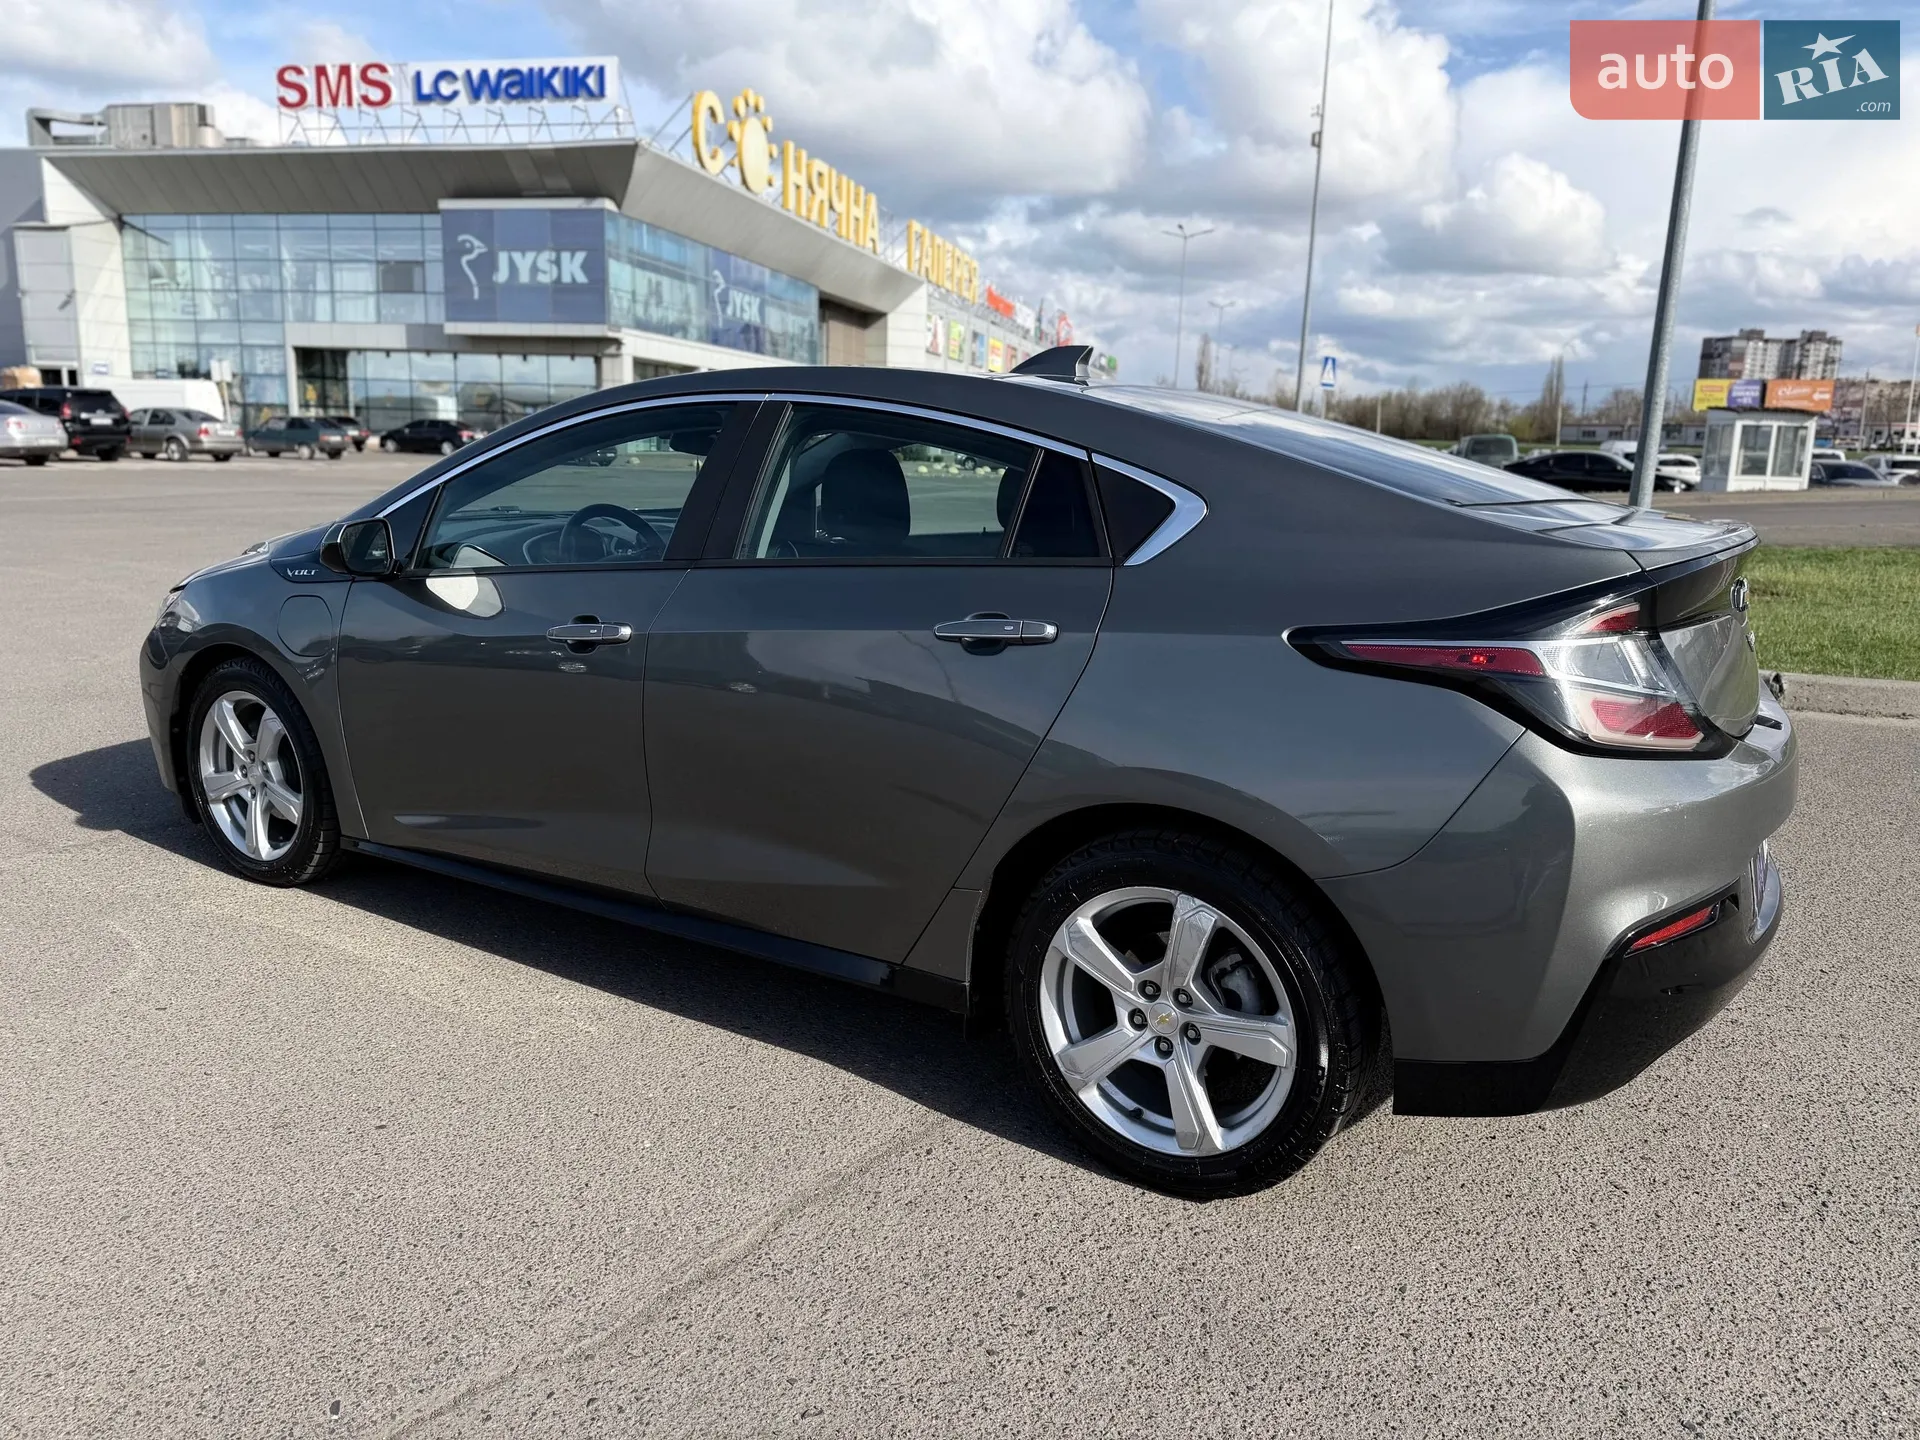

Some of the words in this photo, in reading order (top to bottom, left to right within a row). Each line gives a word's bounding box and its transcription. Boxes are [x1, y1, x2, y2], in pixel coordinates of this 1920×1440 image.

[276, 63, 394, 109] SMS
[413, 69, 460, 102] LC
[492, 250, 589, 284] JYSK
[725, 288, 762, 324] JYSK
